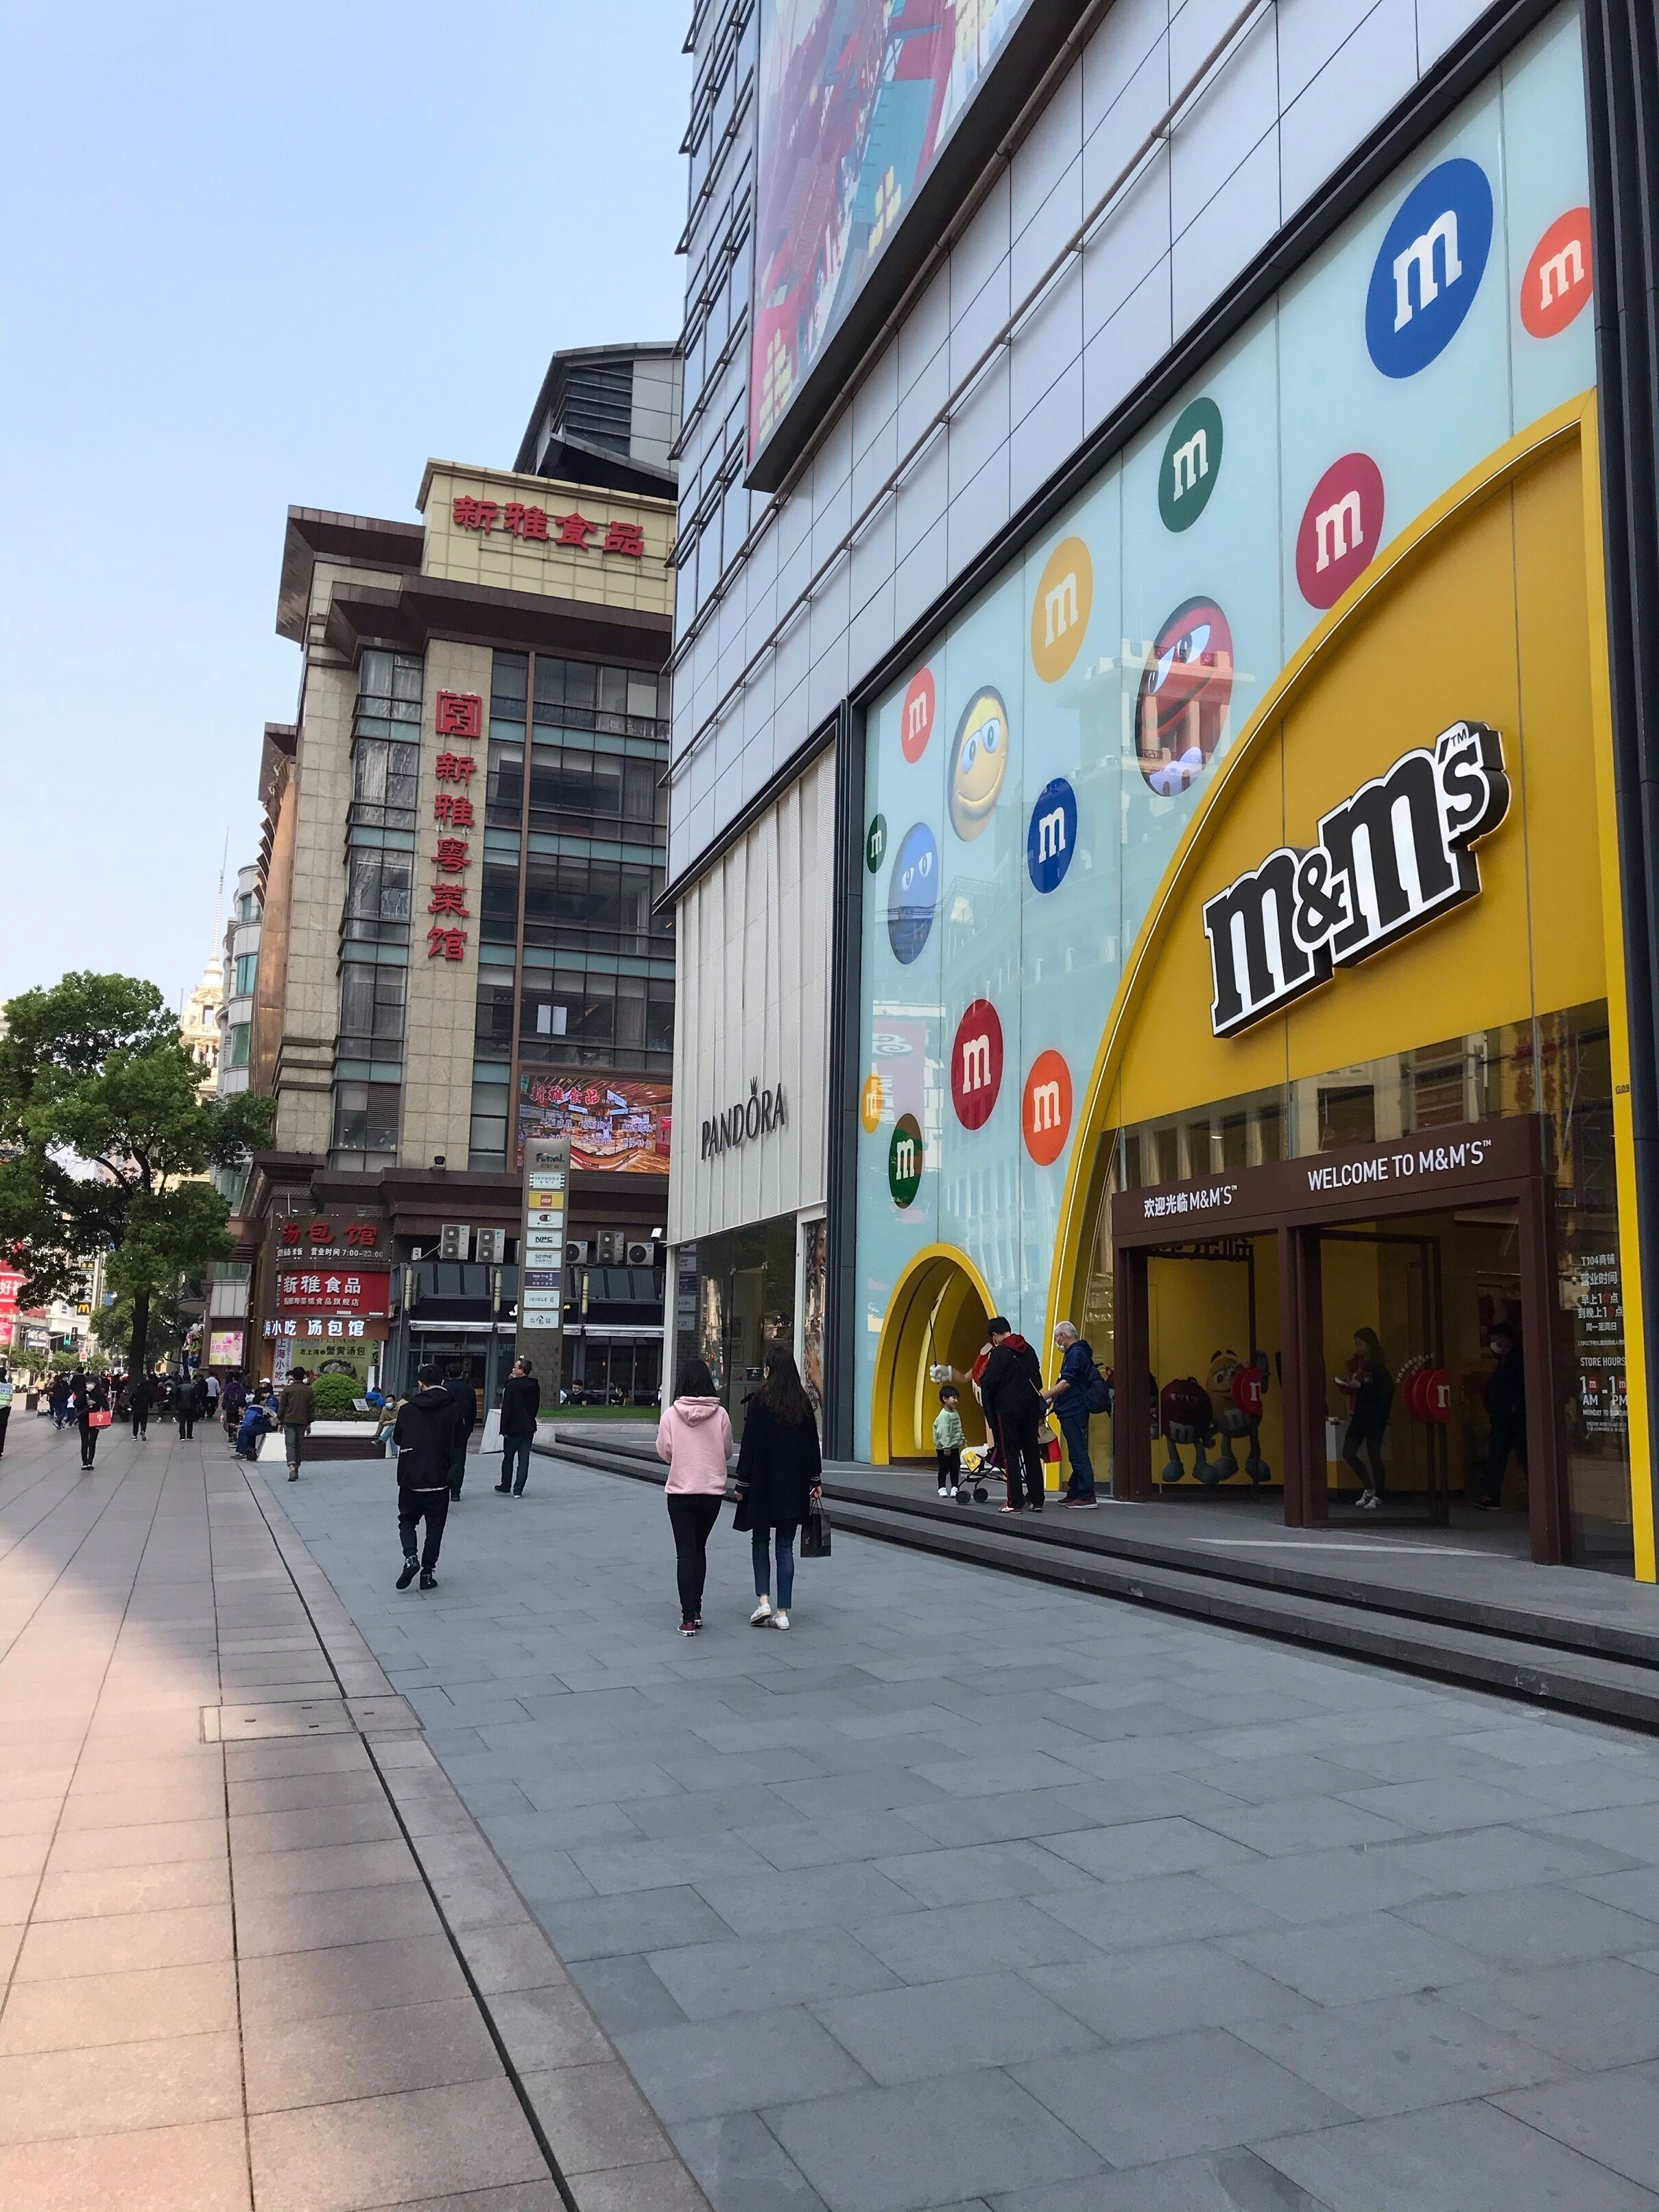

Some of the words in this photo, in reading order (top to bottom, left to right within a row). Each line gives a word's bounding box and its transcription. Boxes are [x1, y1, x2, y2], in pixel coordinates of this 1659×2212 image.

[453, 495, 645, 556] 新雅食品
[427, 752, 477, 960] 新雅粤菜馆
[529, 1084, 600, 1105] 新雅食品
[701, 1082, 785, 1161] PANDORA
[1307, 1158, 1388, 1191] WELCOME
[1392, 1155, 1414, 1176] TO
[1144, 1192, 1188, 1218] 欢迎光临
[282, 1222, 379, 1246] 汤包馆
[311, 1248, 340, 1257] 营业时间
[283, 1276, 361, 1294] 新雅食品
[1580, 1272, 1617, 1287] 营业时间
[307, 1320, 365, 1337] 汤包馆
[274, 1338, 286, 1381] 上海小吃
[1580, 1357, 1601, 1366] STORE
[1603, 1357, 1627, 1366] HOURS
[1583, 1394, 1598, 1405] AM
[1612, 1394, 1627, 1405] PM
